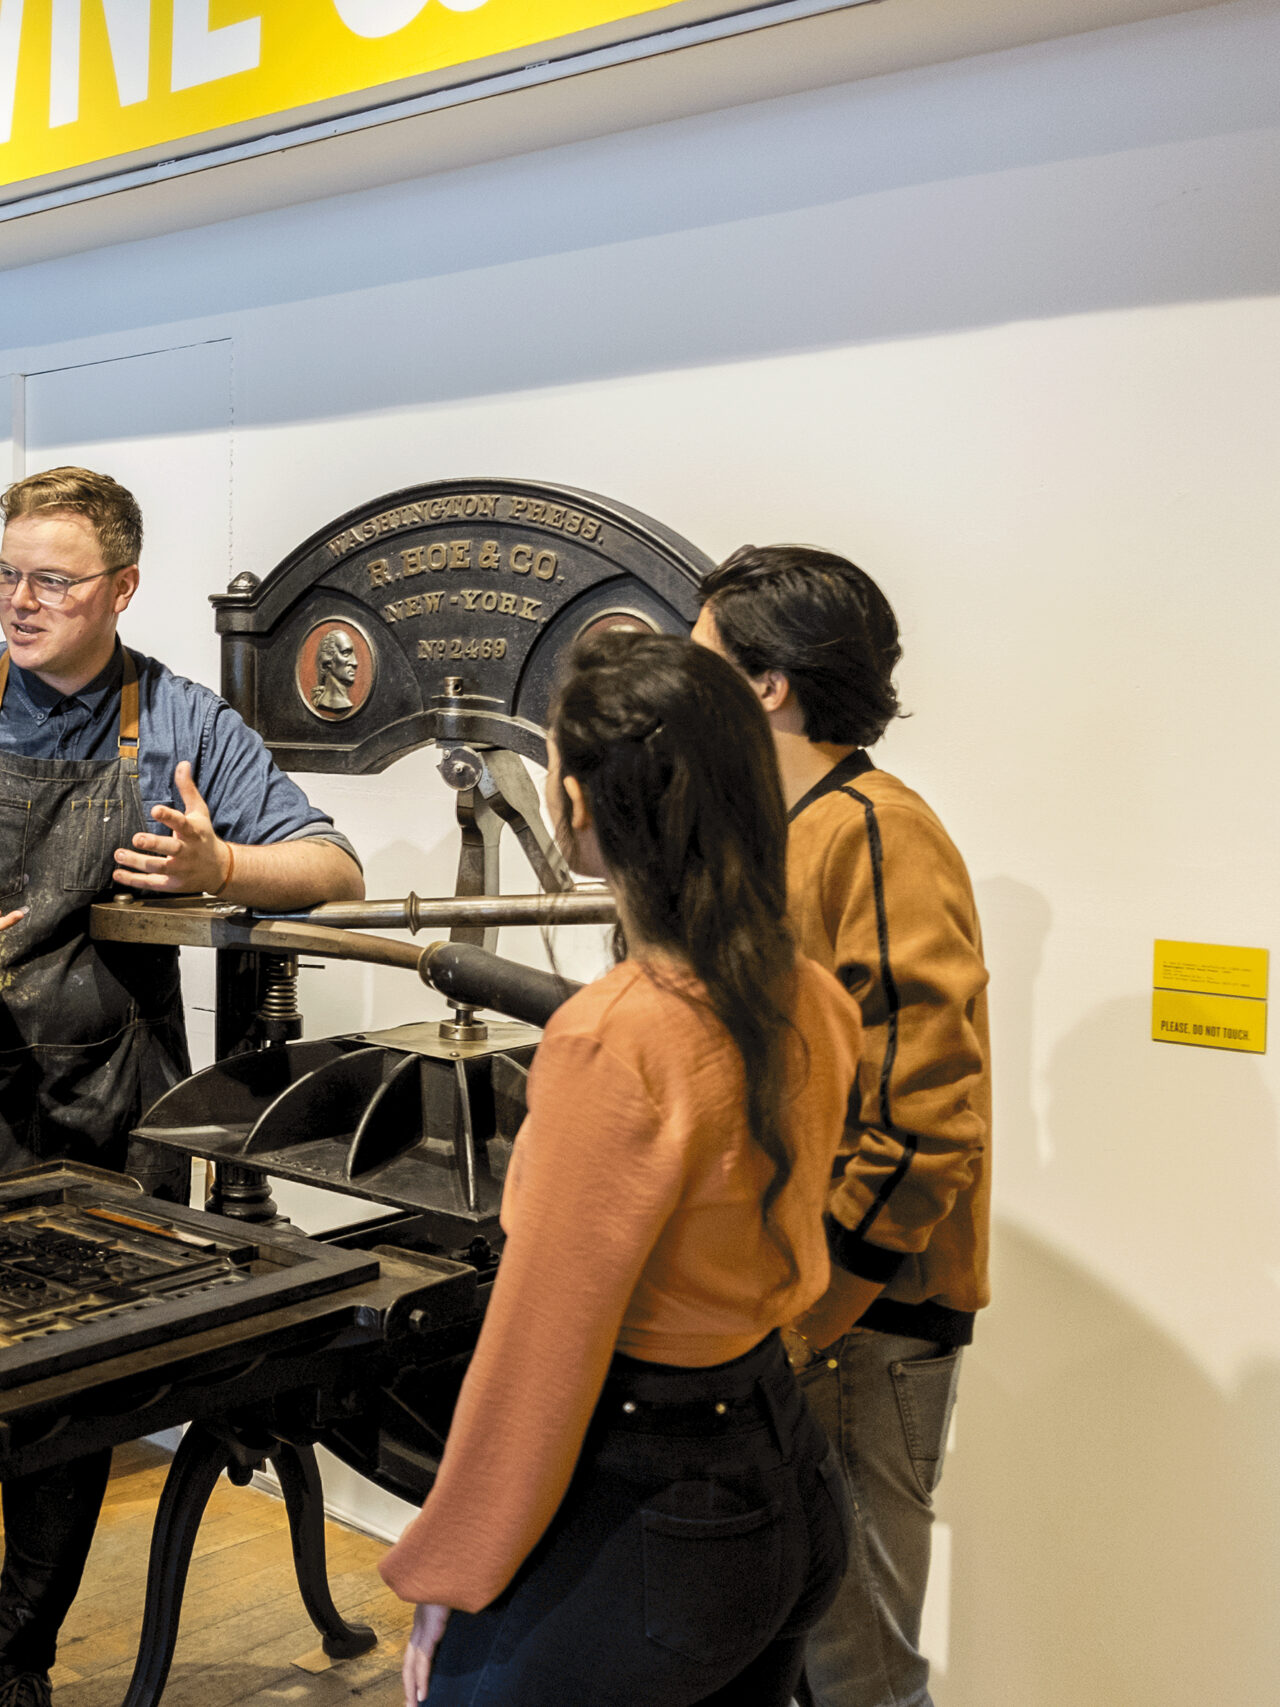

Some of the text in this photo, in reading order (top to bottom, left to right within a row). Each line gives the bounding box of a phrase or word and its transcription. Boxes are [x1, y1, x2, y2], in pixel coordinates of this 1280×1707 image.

[325, 495, 604, 558] WASHINGTON PRESS.
[477, 540, 500, 570] &
[509, 543, 565, 585] CO.
[1192, 1024, 1204, 1036] DO
[1205, 1025, 1220, 1038] NOT
